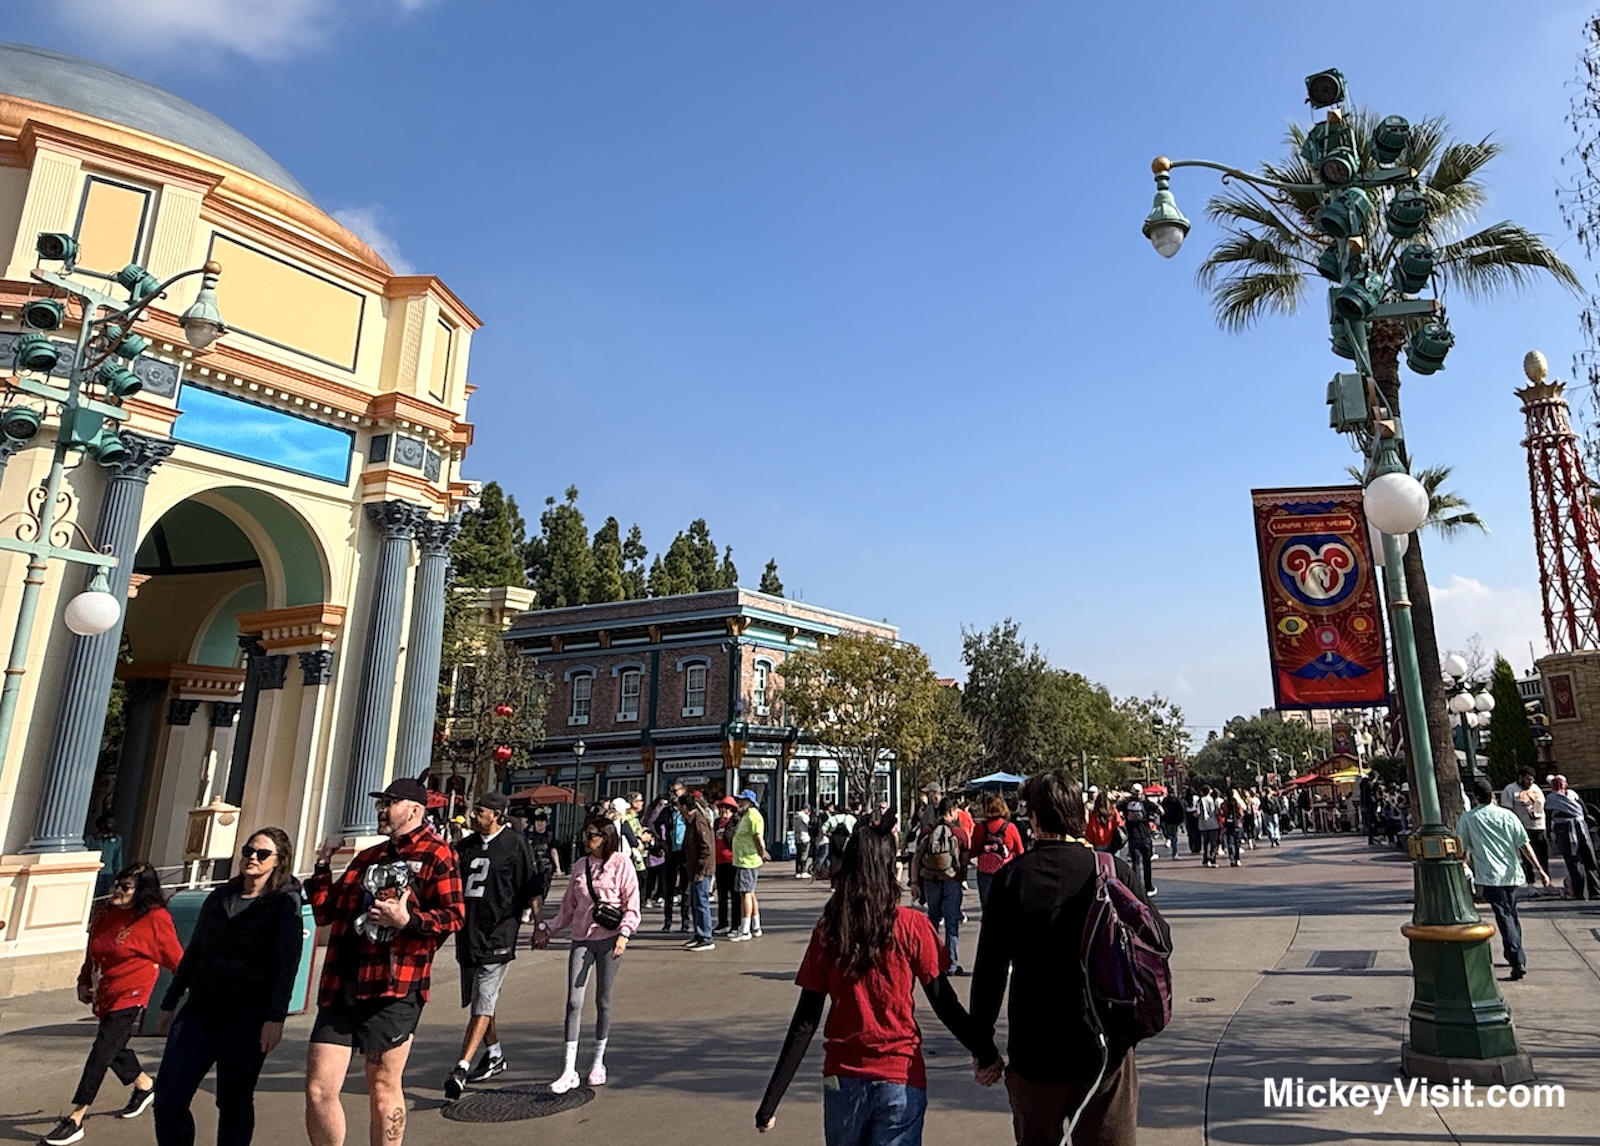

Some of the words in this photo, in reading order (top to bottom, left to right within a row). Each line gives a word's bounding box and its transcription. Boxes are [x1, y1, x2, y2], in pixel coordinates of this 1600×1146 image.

[1272, 522, 1302, 530] LUNAR
[1327, 519, 1352, 527] YEAR
[464, 857, 491, 897] 2
